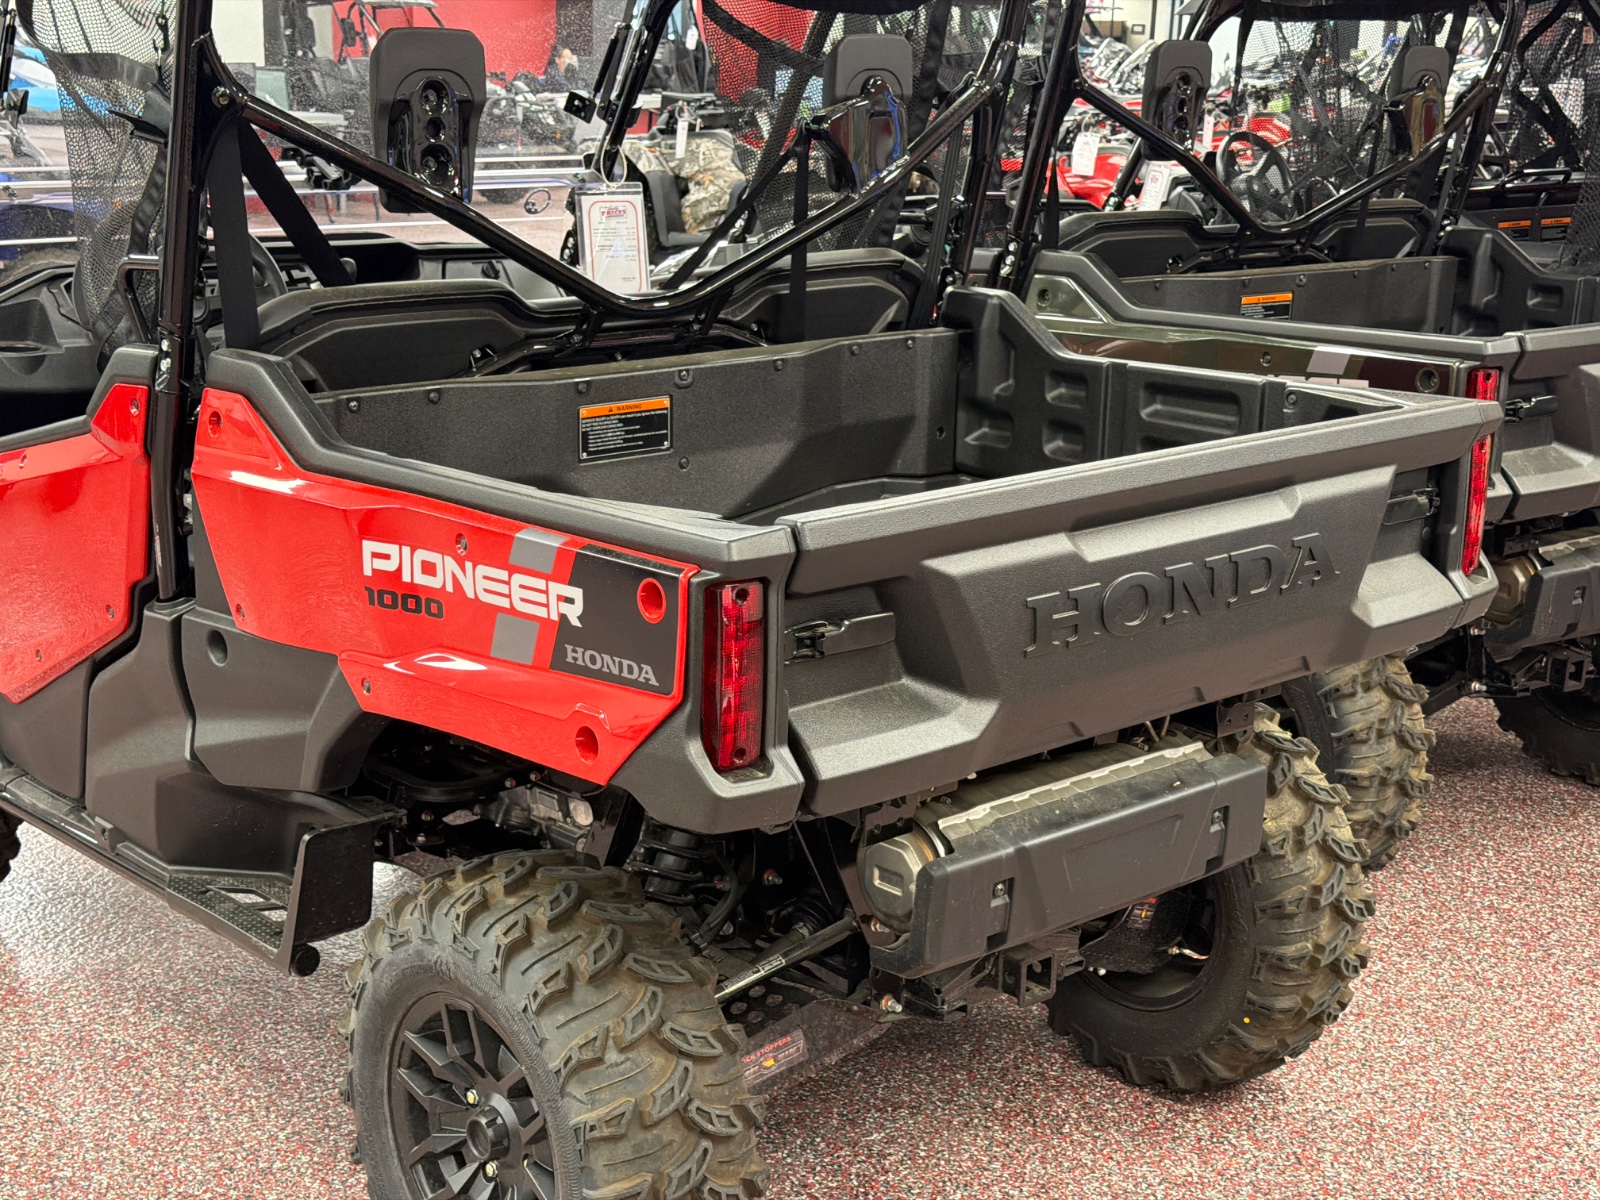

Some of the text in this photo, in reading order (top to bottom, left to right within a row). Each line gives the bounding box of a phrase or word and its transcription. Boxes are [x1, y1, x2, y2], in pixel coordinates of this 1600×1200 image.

[616, 403, 643, 412] WARNING
[362, 539, 584, 628] PIONEER
[364, 586, 445, 620] 1000
[1023, 531, 1341, 659] HONDA
[564, 643, 660, 687] HONDA
[757, 1036, 792, 1056] STOPPERS
